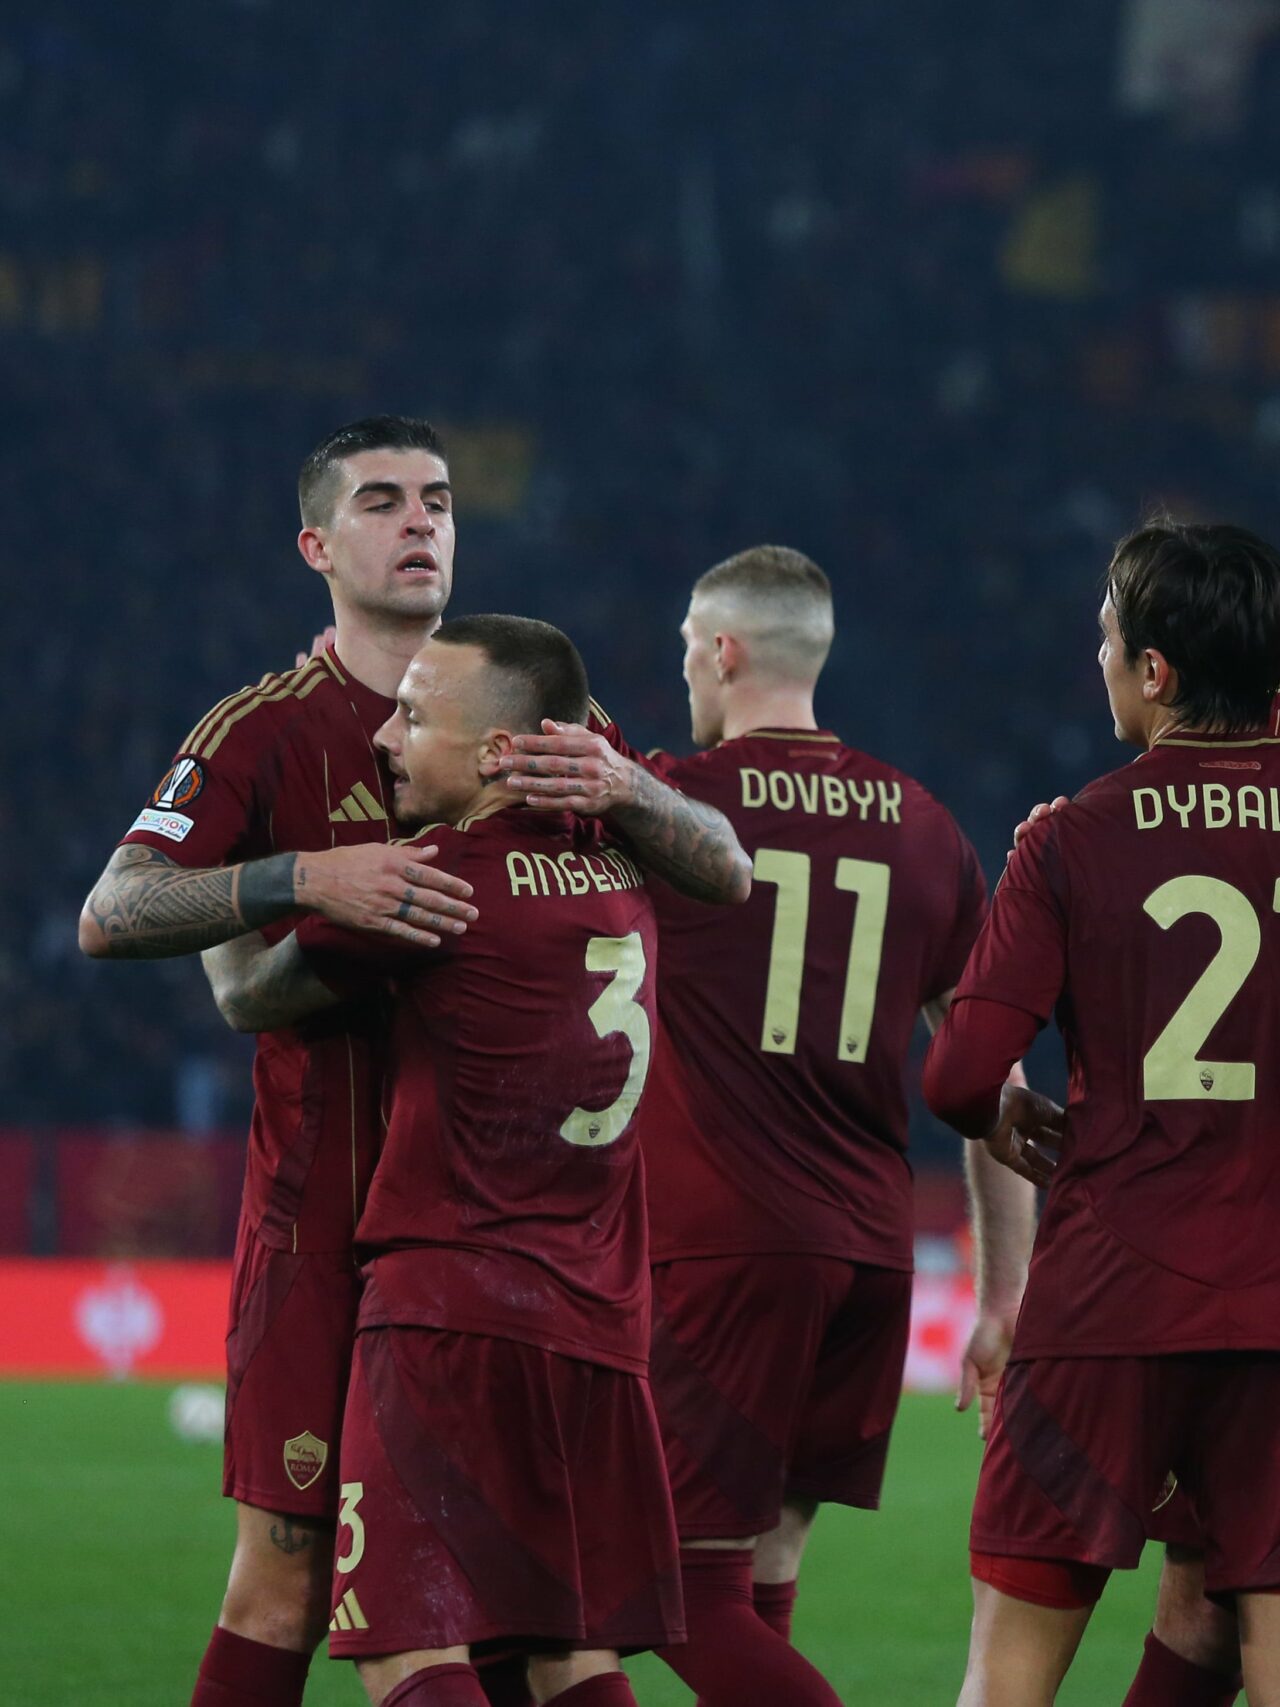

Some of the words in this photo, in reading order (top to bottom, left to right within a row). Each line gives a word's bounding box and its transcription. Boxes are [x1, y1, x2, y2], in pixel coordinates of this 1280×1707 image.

[740, 768, 902, 824] DOVBYK
[753, 848, 891, 1064] 11
[559, 932, 651, 1146] 3
[336, 1481, 366, 1574] 3
